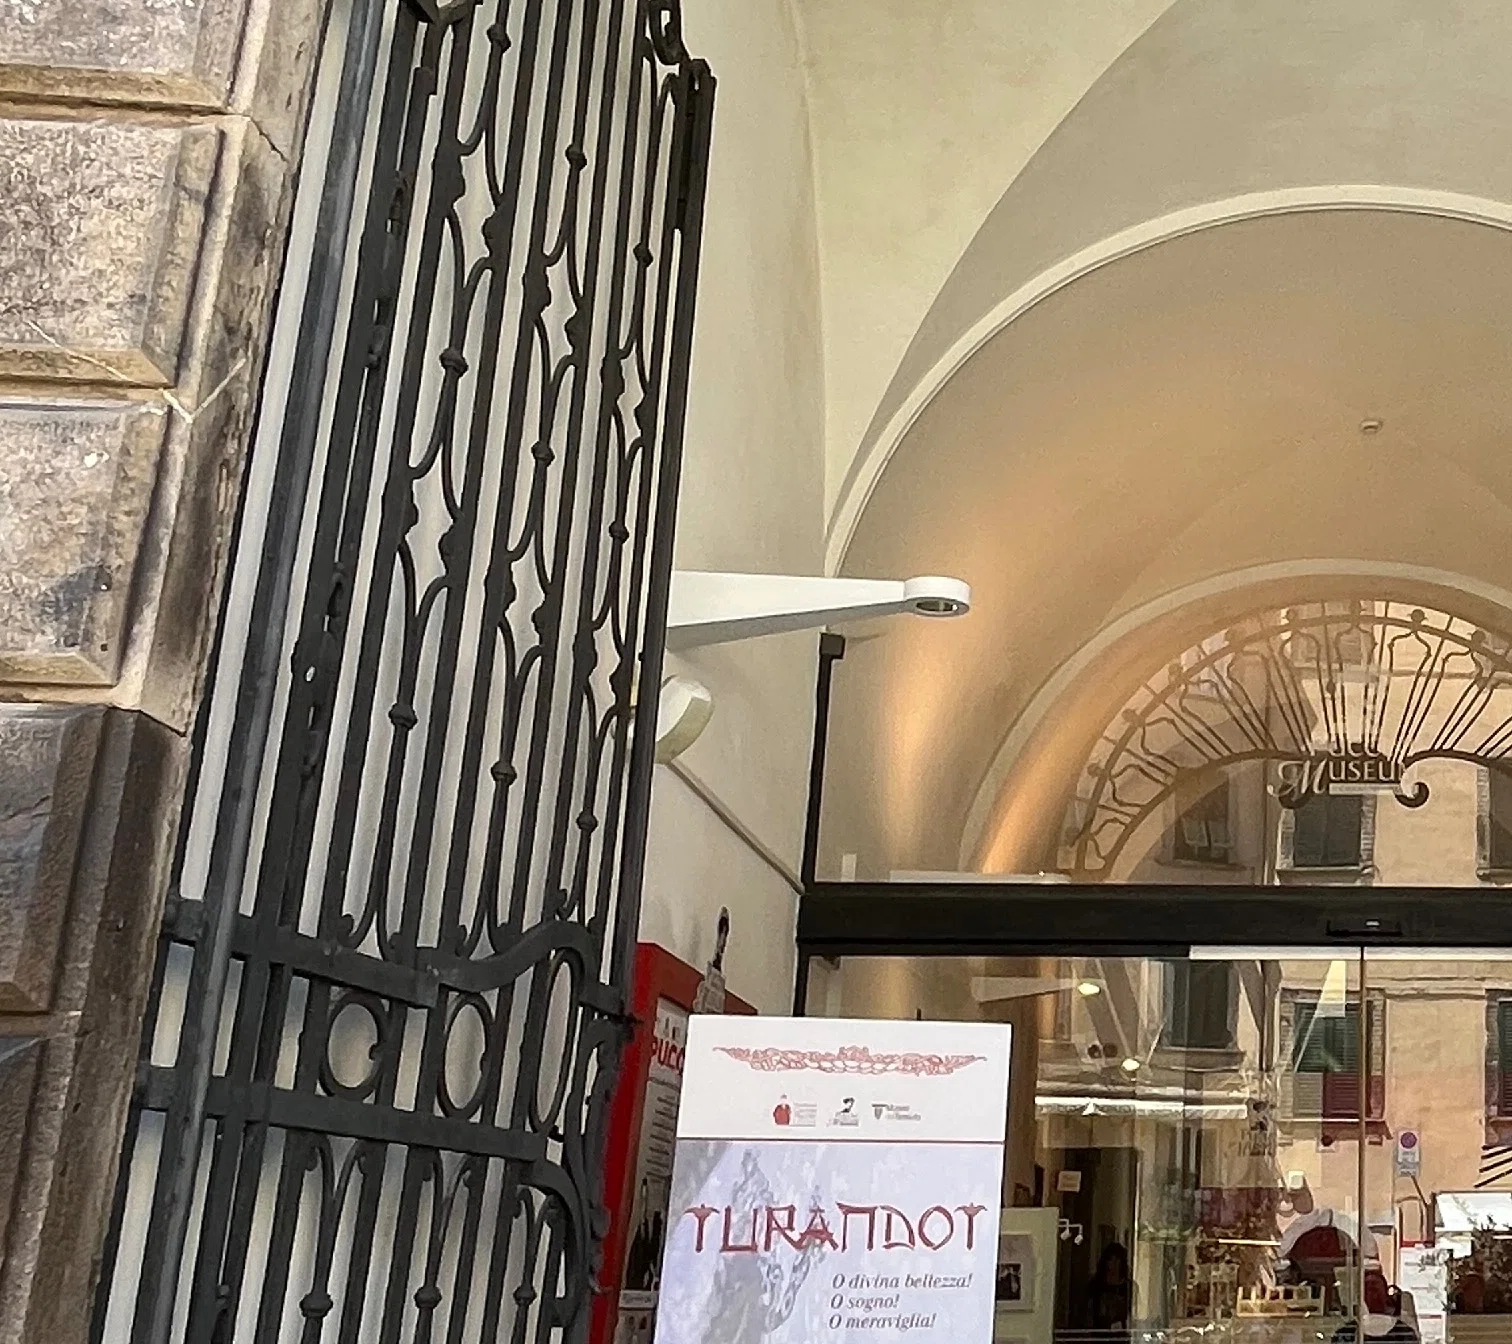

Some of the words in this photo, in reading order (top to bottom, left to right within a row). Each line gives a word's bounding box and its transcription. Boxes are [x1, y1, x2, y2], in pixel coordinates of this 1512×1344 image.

[1267, 758, 1406, 797] MUSEU
[684, 1203, 988, 1253] TURANDOT
[832, 1273, 846, 1289] O
[849, 1273, 900, 1289] divina
[904, 1273, 973, 1289] bellezza!
[830, 1293, 844, 1309] O
[849, 1293, 900, 1313] sogno!
[829, 1313, 843, 1329] O
[846, 1313, 937, 1331] meraviglia!
